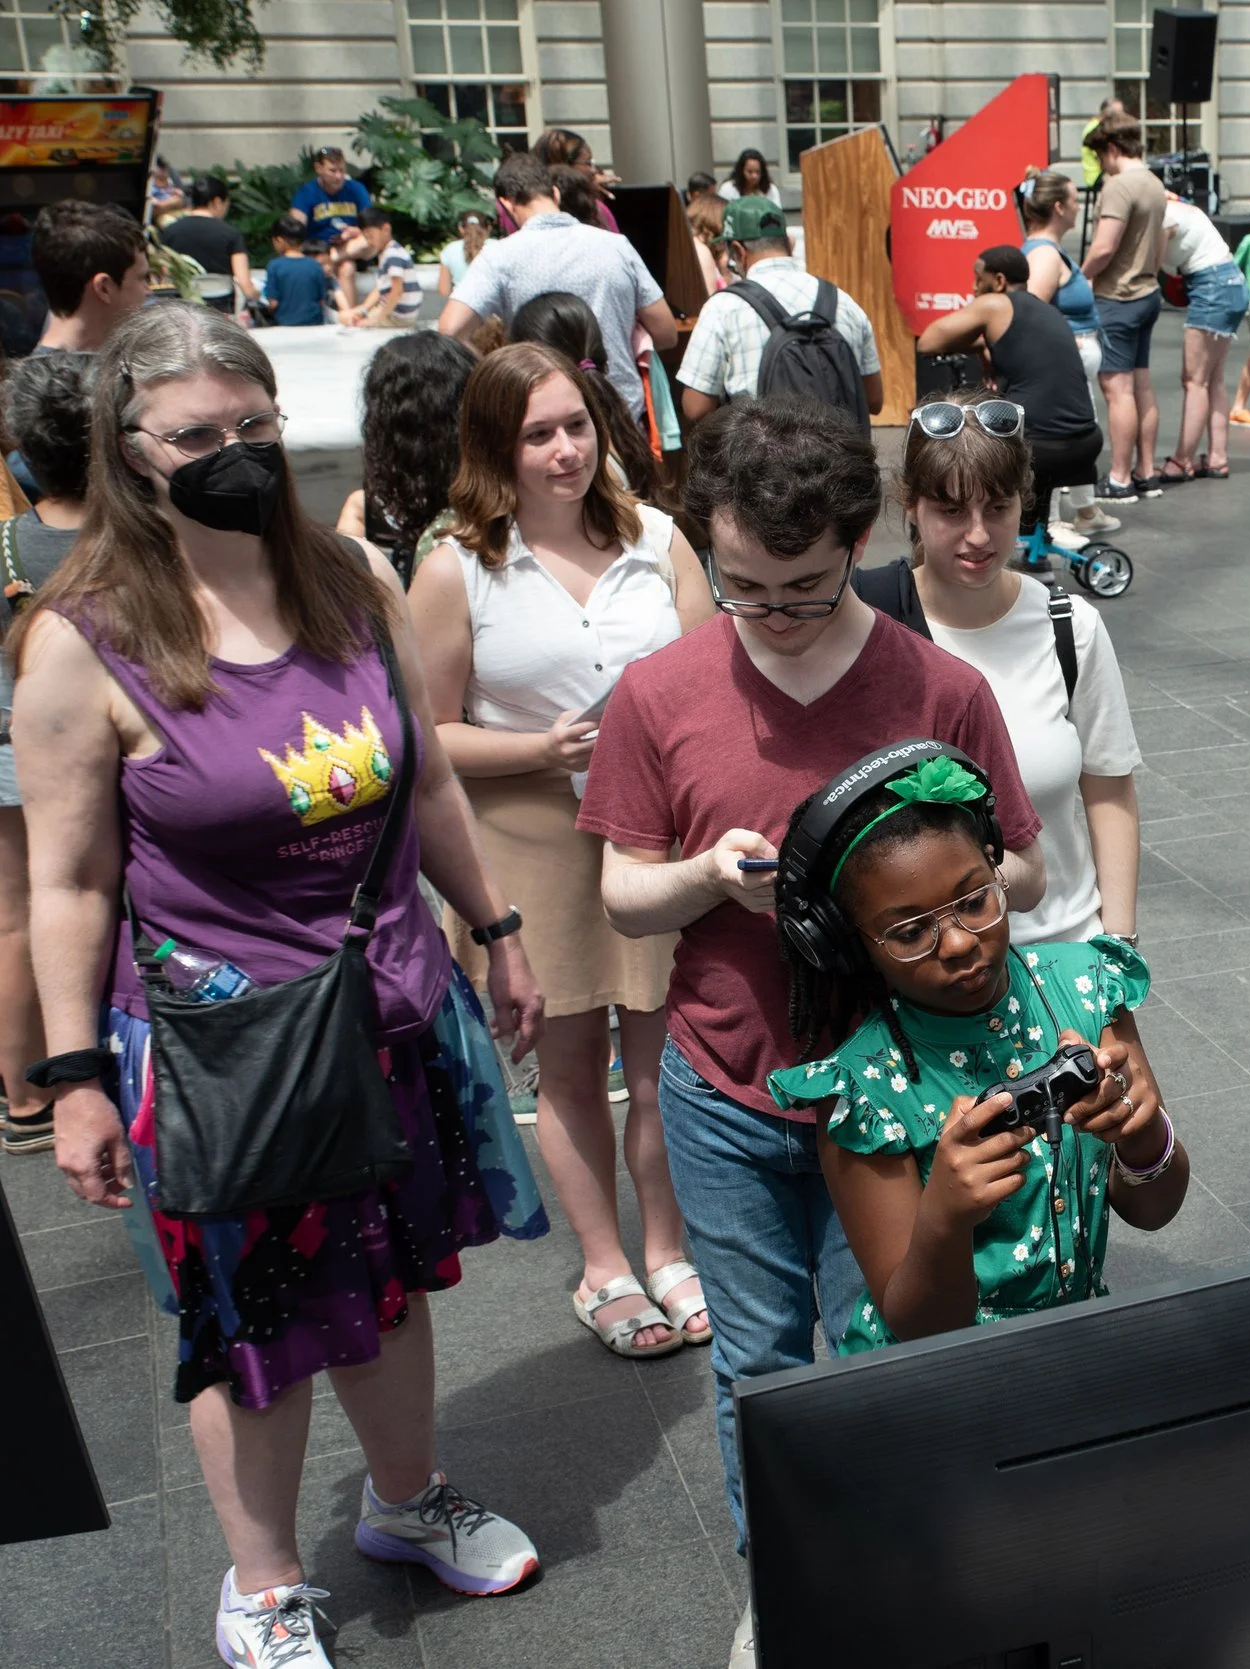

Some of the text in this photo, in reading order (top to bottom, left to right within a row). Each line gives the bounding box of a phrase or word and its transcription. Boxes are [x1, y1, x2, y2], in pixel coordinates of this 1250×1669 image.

[926, 219, 979, 239] MVS
[932, 292, 975, 310] SN
[827, 741, 929, 803] audio-technica
